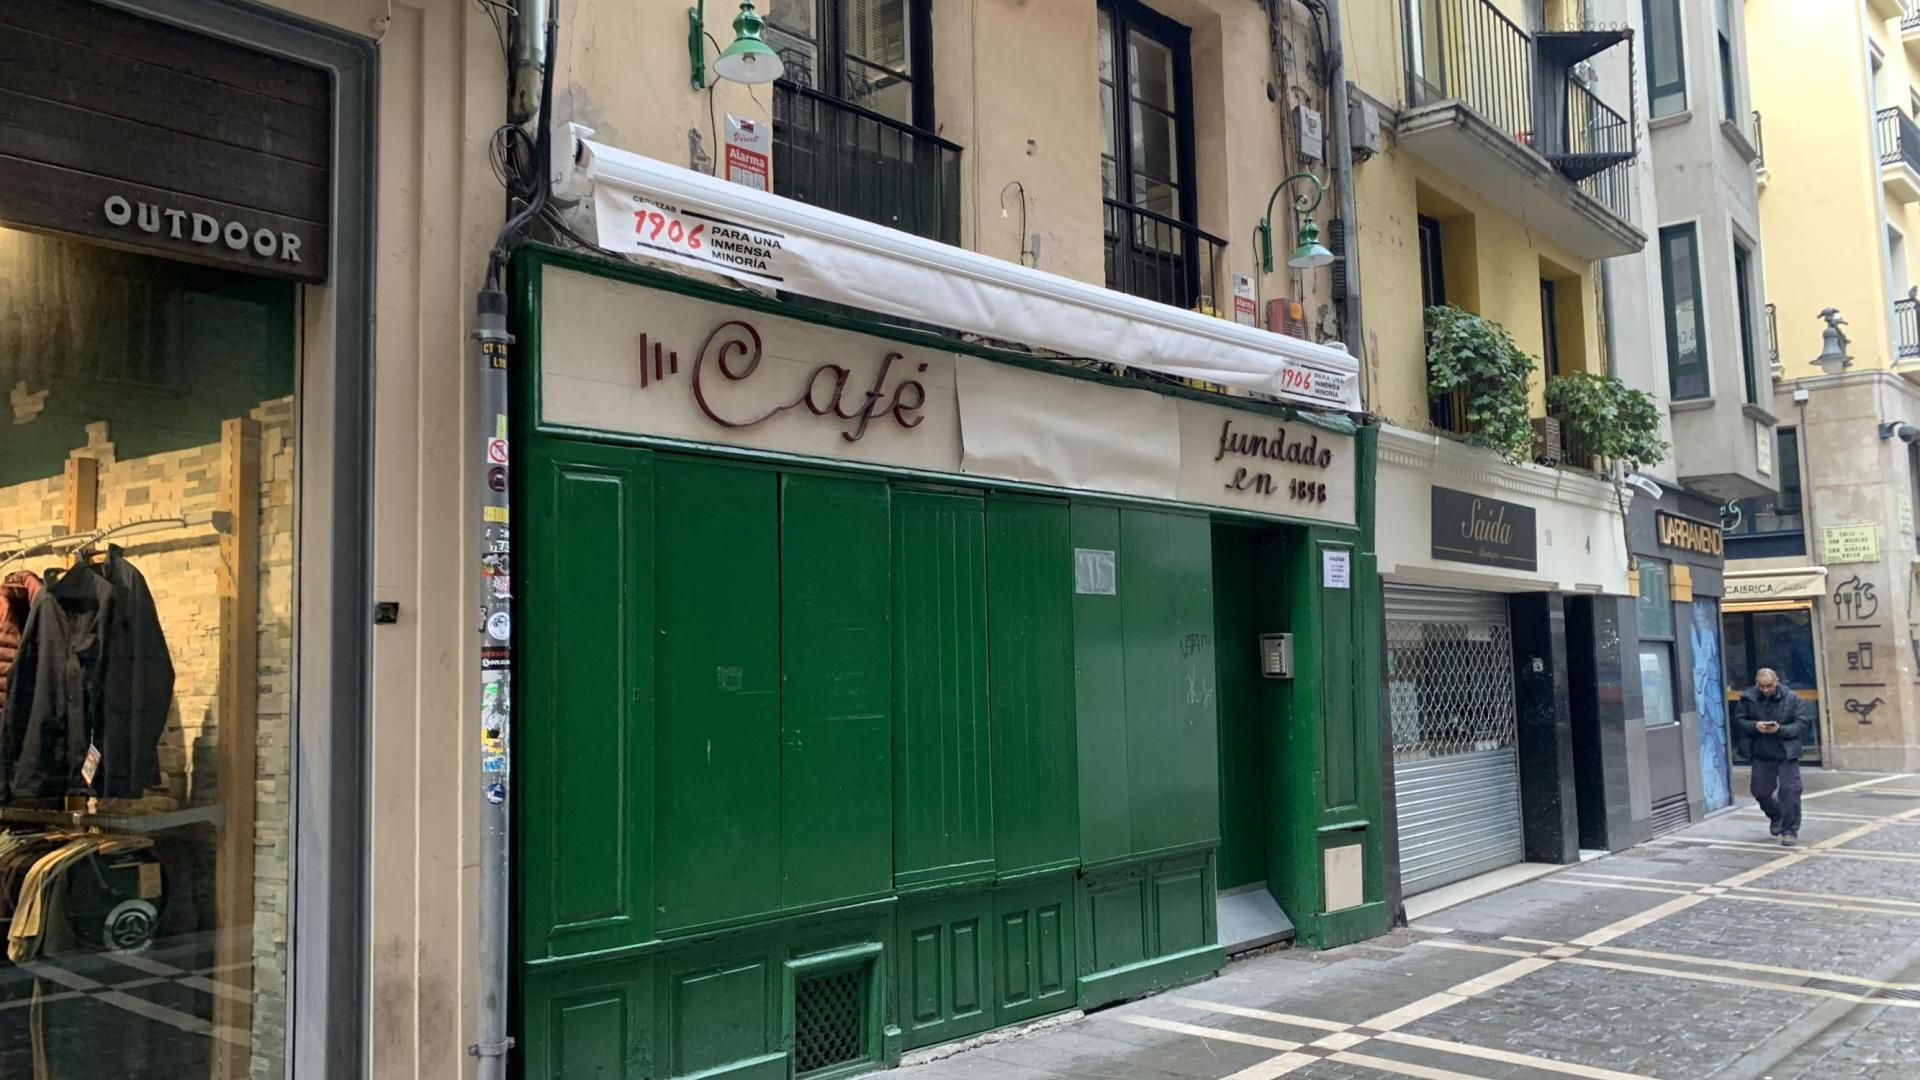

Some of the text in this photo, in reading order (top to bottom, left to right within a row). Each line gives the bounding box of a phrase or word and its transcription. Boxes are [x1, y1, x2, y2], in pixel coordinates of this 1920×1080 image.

[729, 148, 765, 168] Alarma
[632, 195, 677, 213] CERVEZAS
[104, 195, 302, 262] OUTDOOR
[634, 209, 705, 249] 1906
[711, 226, 782, 250] PARA UNA
[711, 238, 772, 259] INMENSA
[711, 250, 767, 270] MINORÍA
[692, 320, 929, 442] Café
[1281, 368, 1312, 390] 1906
[1314, 373, 1331, 381] PARA
[1314, 380, 1340, 390] INMENSA
[1225, 467, 1279, 494] en
[1461, 498, 1513, 545] Saida
